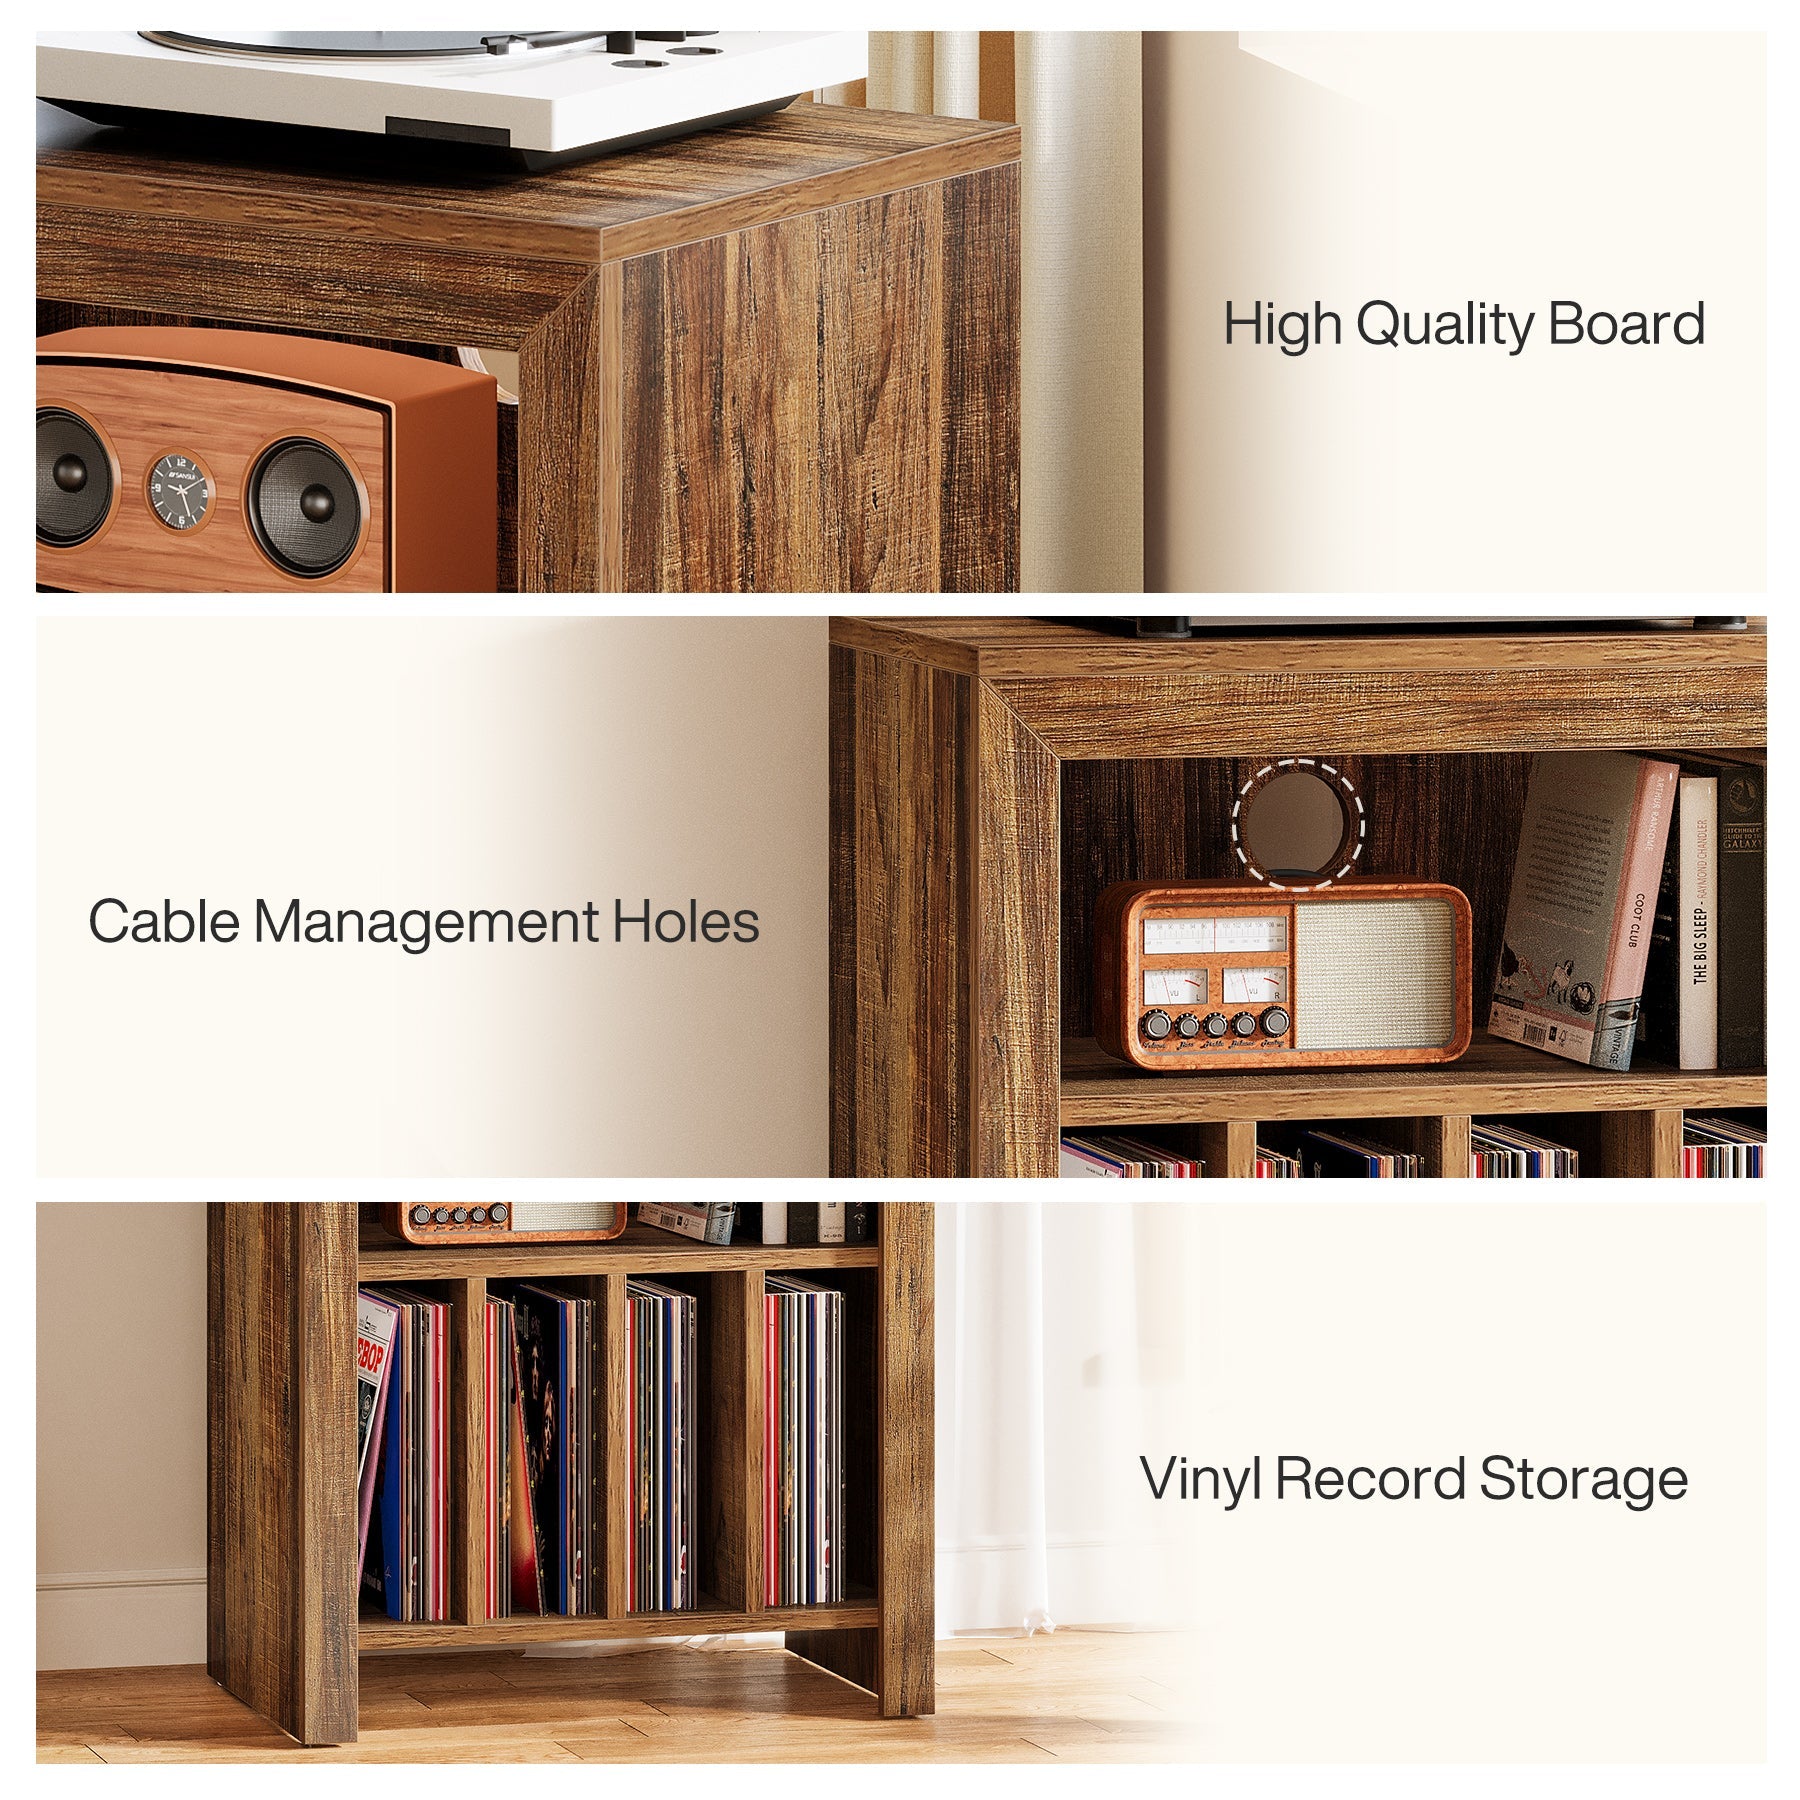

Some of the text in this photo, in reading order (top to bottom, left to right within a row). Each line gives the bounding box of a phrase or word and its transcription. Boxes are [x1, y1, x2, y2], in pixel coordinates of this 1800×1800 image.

[177, 458, 186, 467] 12
[155, 483, 161, 492] 9
[202, 489, 208, 498] 3
[179, 516, 185, 525] 6
[1697, 820, 1707, 858] CHANDLER
[1723, 840, 1763, 849] GALAXY
[1697, 861, 1707, 899] RAYMOND
[1629, 893, 1645, 948] COOT CLUB
[1694, 908, 1707, 938] SLEEP
[1694, 942, 1707, 960] BIG
[1694, 964, 1707, 985] THE
[1610, 1029, 1622, 1064] VINTAGE
